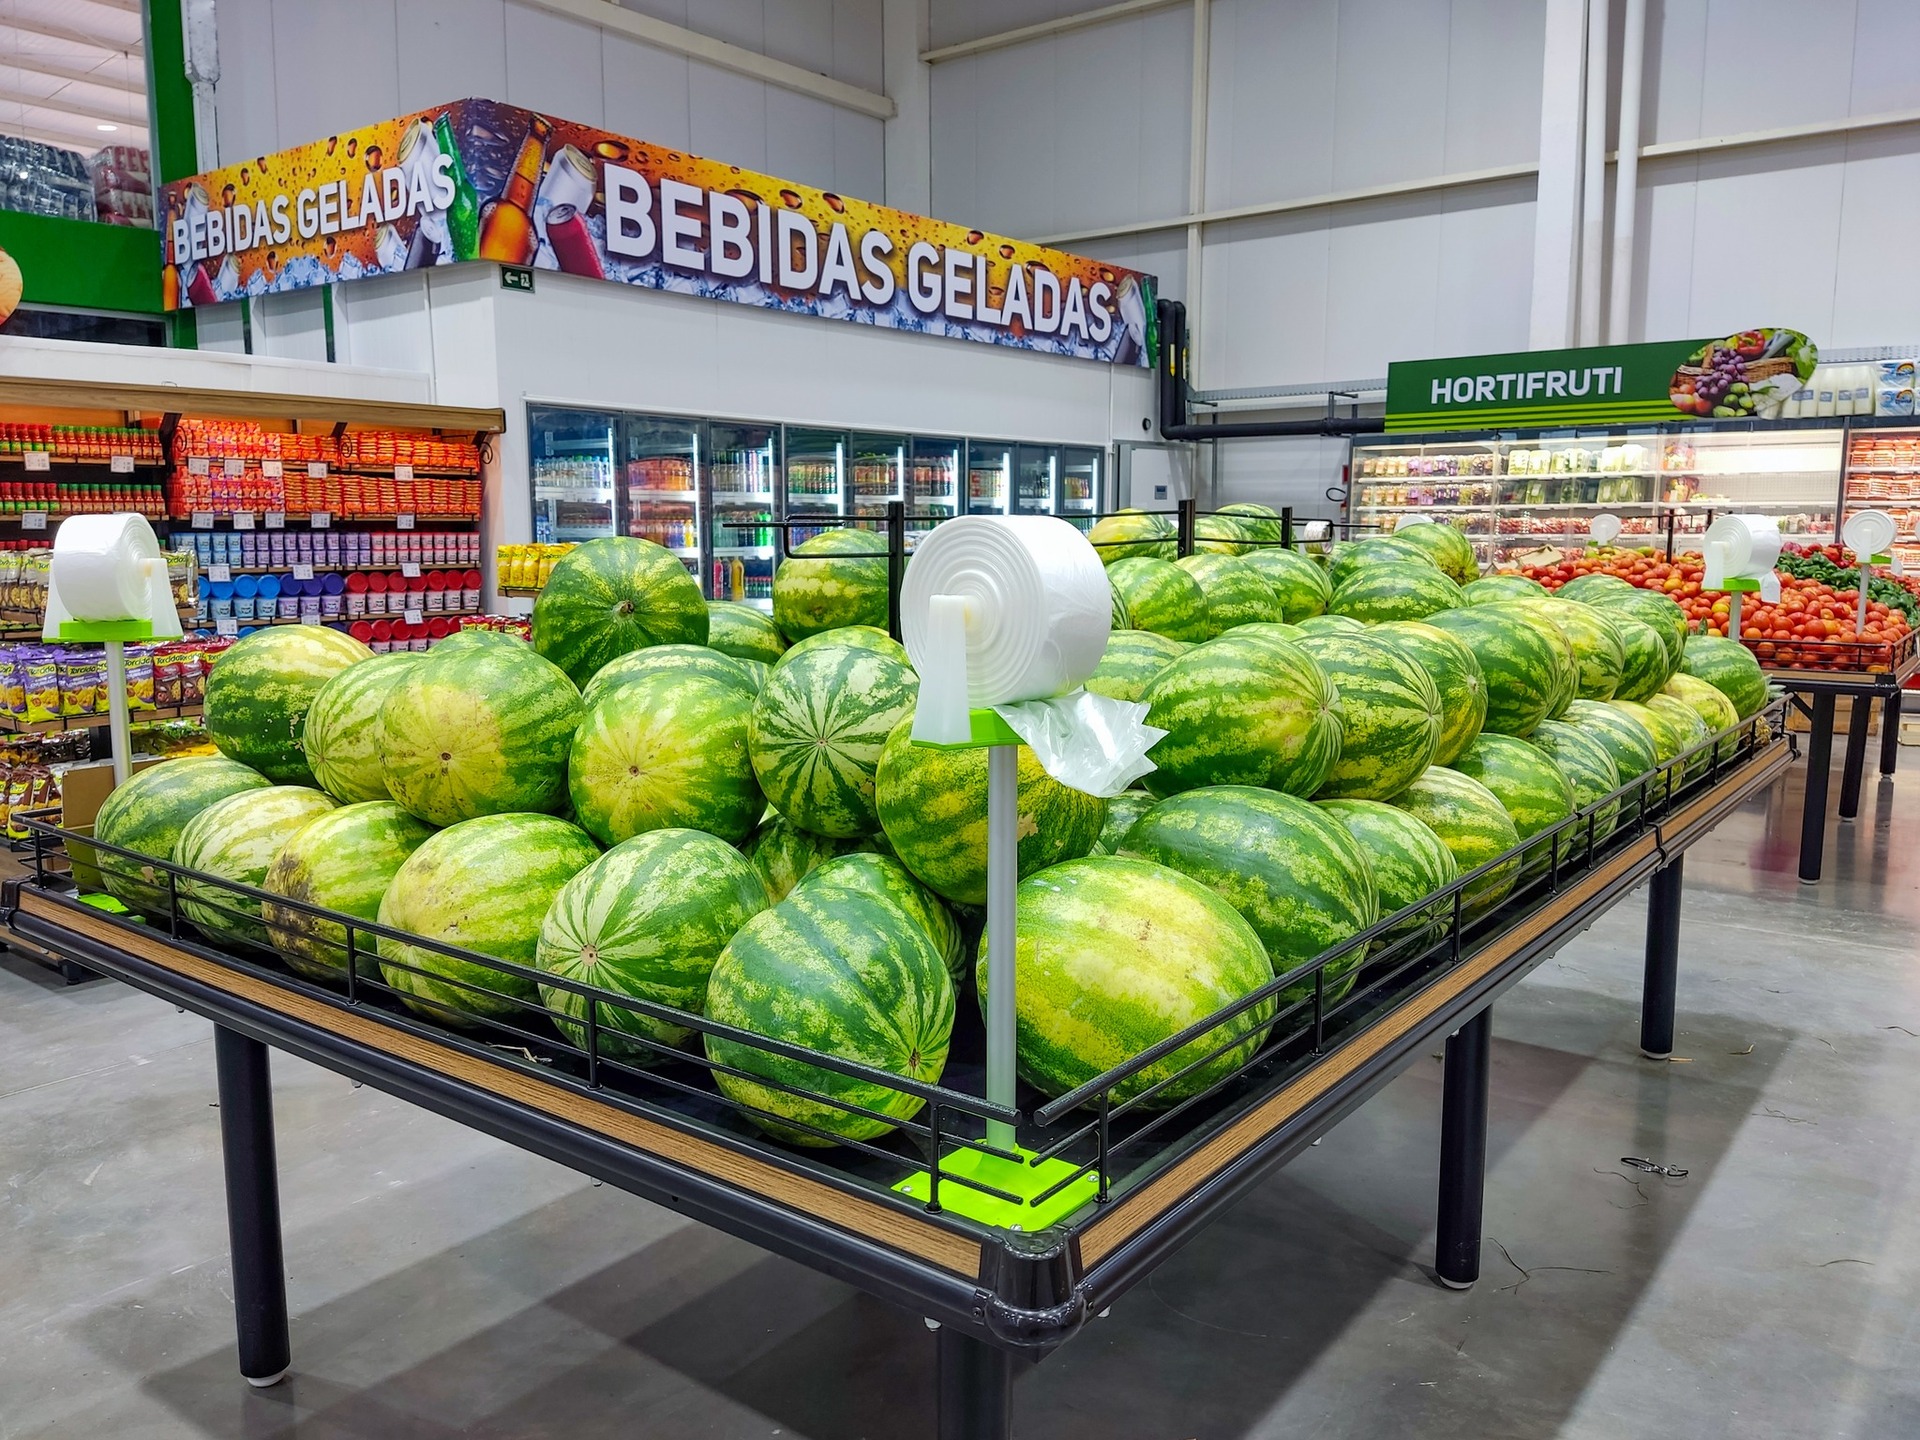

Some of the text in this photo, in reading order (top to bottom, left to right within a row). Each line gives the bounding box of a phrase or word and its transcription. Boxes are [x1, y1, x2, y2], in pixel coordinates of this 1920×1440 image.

[172, 153, 456, 265] BEBIDAS GELADAS
[602, 162, 1113, 343] BEBIDAS GELADAS
[1431, 366, 1623, 405] HORTIFRUTI
